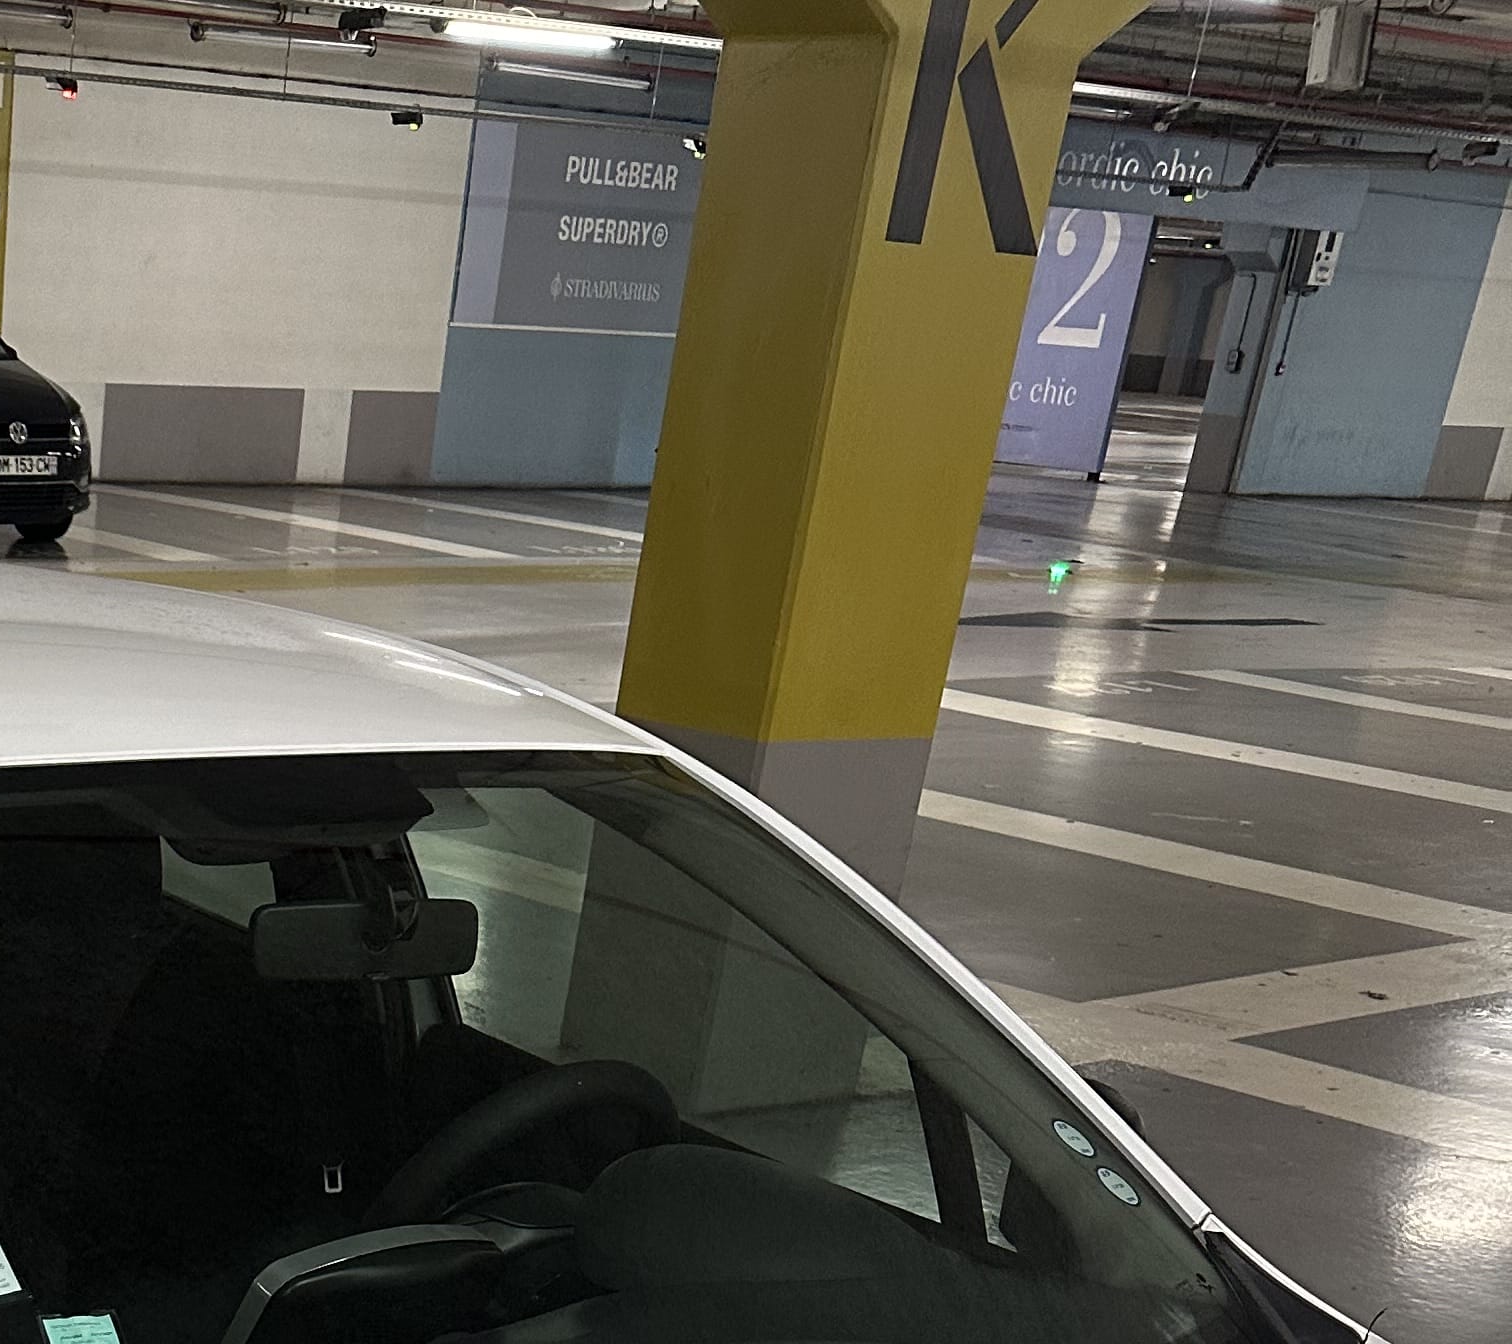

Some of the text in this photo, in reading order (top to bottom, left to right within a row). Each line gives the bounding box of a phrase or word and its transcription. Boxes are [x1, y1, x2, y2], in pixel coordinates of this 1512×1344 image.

[885, 0, 1038, 256] K
[565, 155, 679, 191] PULL&BEAR
[1149, 148, 1213, 199] chic
[564, 278, 661, 303] STRADIVARIUS
[1038, 208, 1122, 349] 2
[1029, 376, 1078, 407] chic
